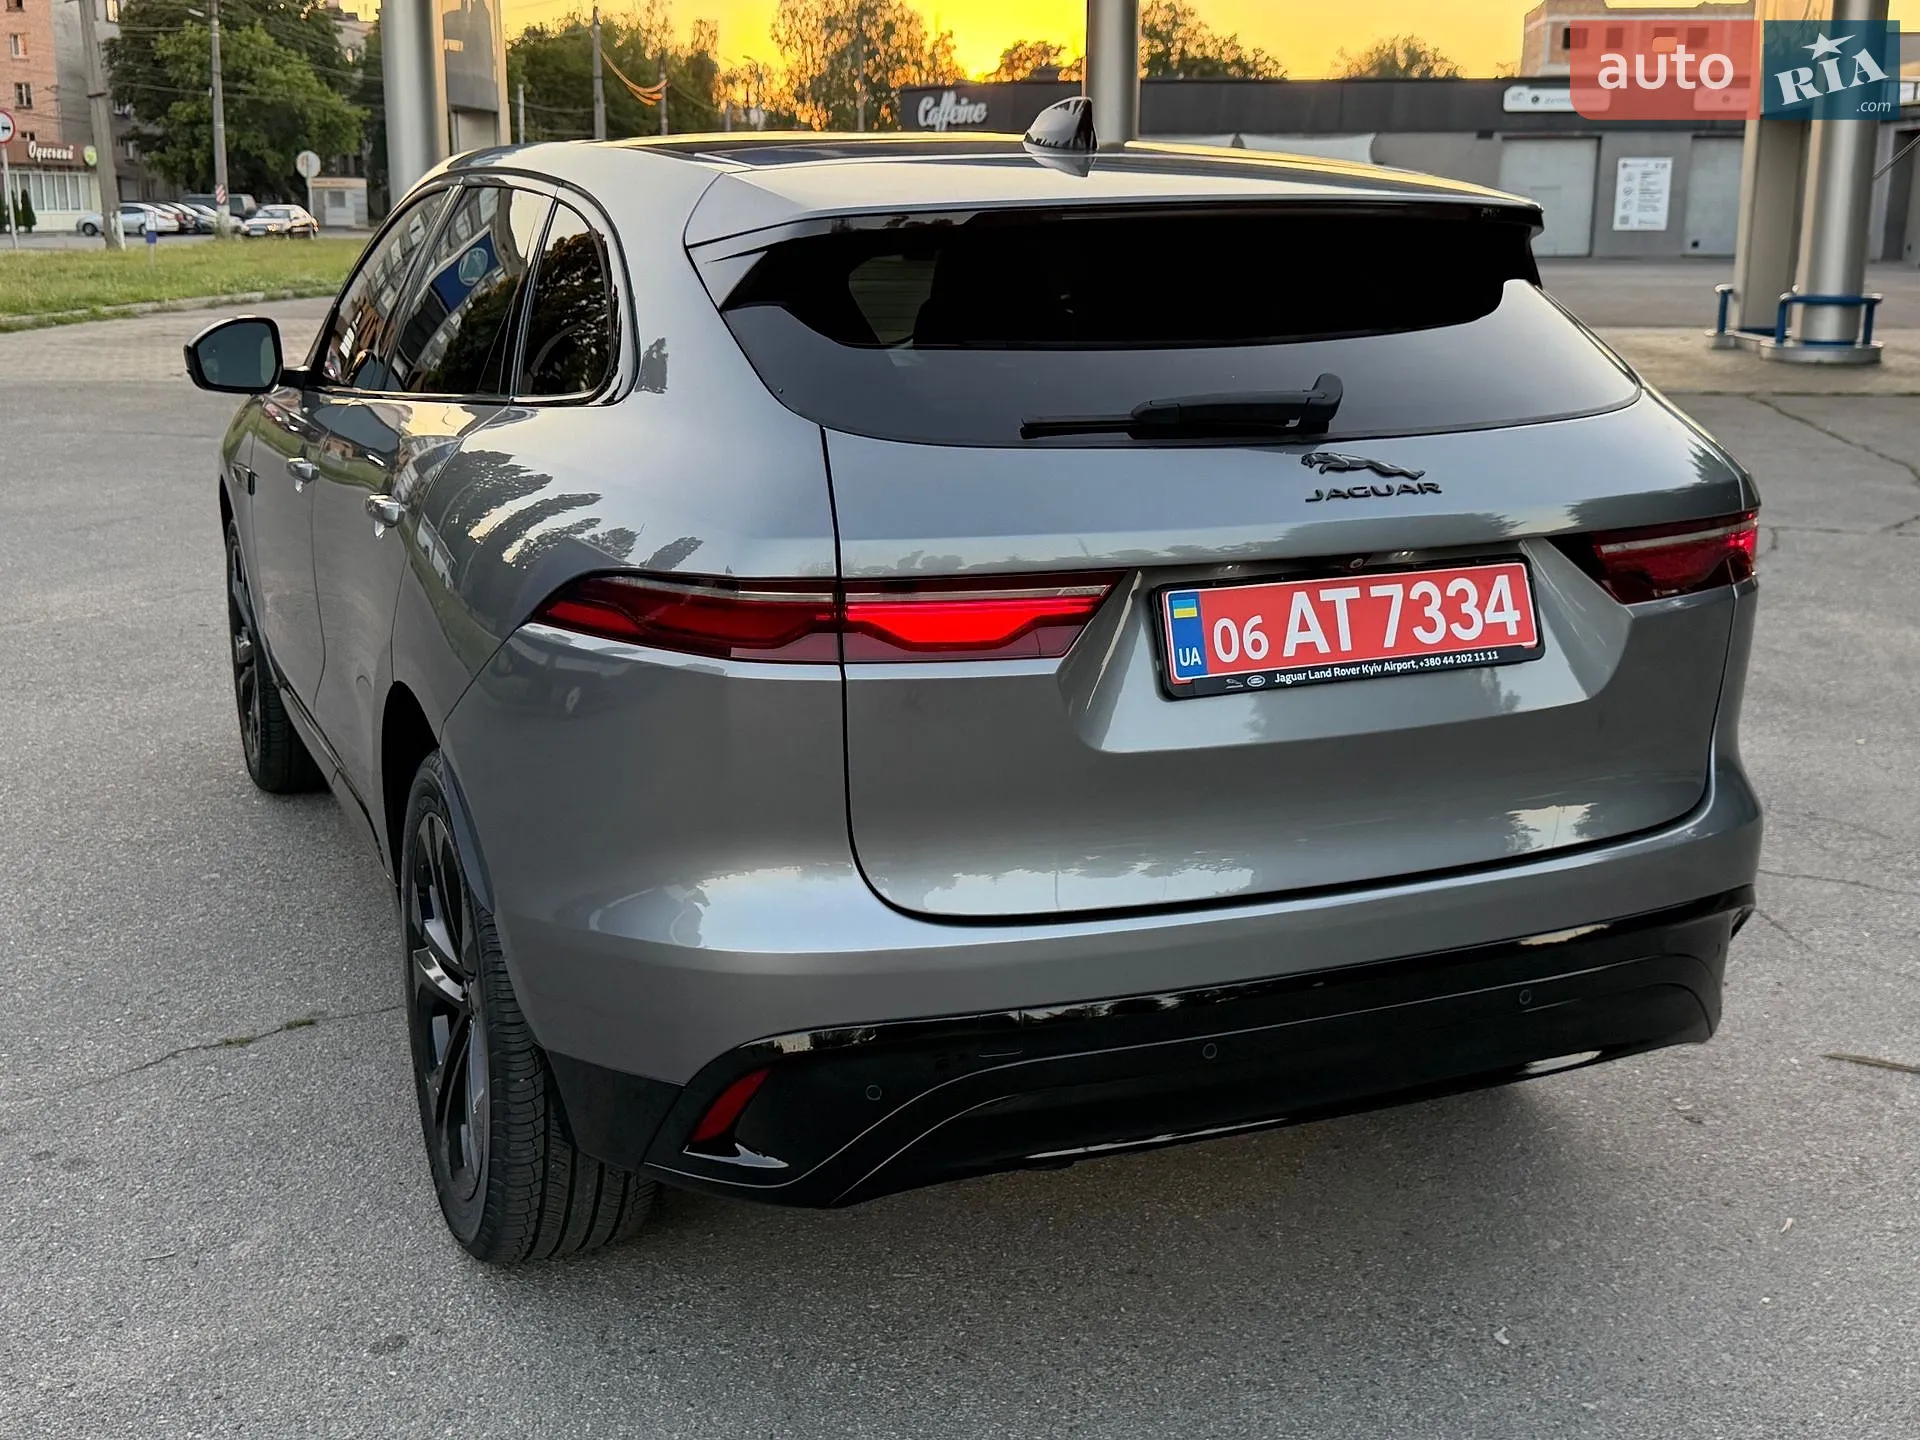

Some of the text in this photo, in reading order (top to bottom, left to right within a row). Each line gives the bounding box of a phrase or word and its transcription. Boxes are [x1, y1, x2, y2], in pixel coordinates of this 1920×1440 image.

[918, 90, 988, 131] Caffeine
[1305, 482, 1442, 502] JAGUAR
[1213, 615, 1269, 663] 06
[1178, 647, 1202, 667] UA
[1274, 672, 1307, 685] Jaguar
[1308, 667, 1332, 680] Land
[1334, 665, 1361, 677] Rover
[1361, 661, 1382, 676] Kyiv
[1383, 659, 1419, 673] Airport,
[1419, 656, 1441, 668] +380
[1442, 655, 1454, 665] 44
[1456, 653, 1473, 664] 202
[1473, 651, 1486, 661] 11
[1487, 650, 1499, 660] 11
